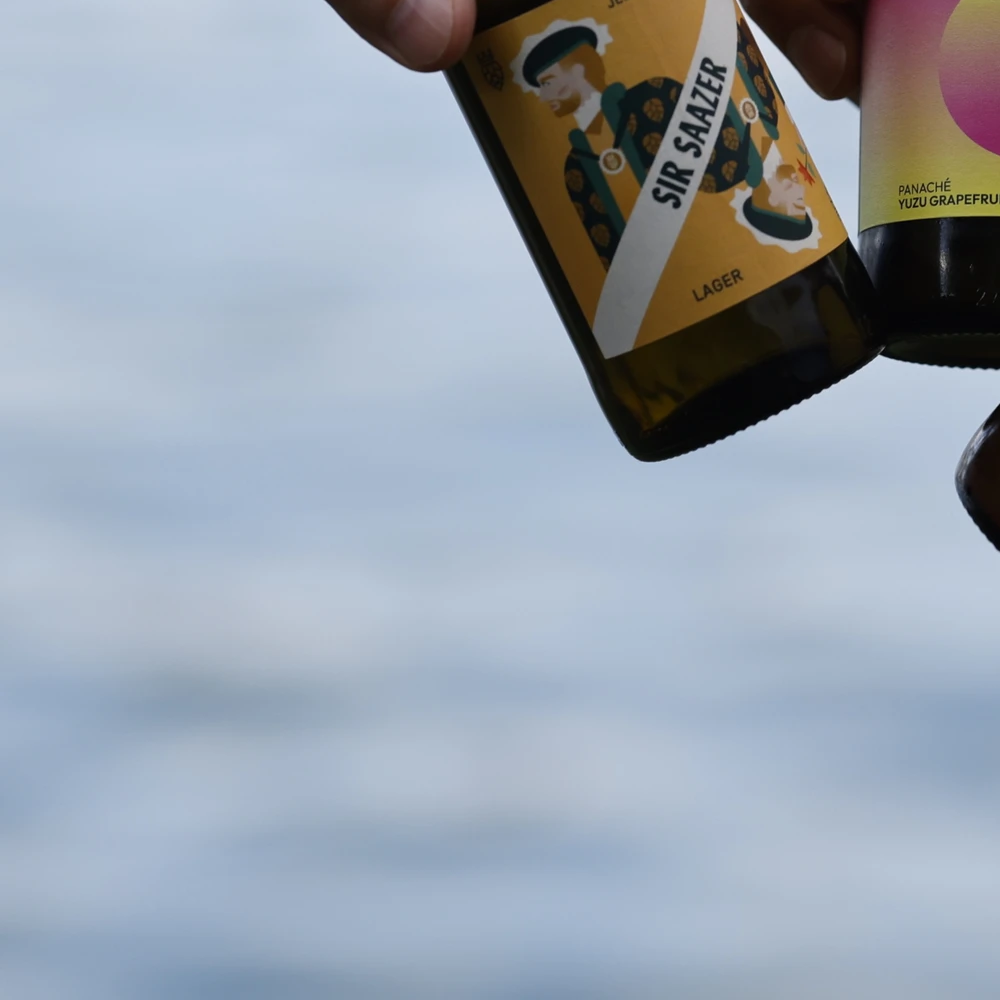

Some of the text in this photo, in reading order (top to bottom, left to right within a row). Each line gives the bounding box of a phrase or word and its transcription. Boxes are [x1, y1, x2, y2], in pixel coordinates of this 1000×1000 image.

[651, 56, 728, 210] SIR SAAZER
[898, 177, 952, 197] PANACHÉ
[898, 196, 928, 210] YUZU
[691, 268, 745, 302] LAGER
